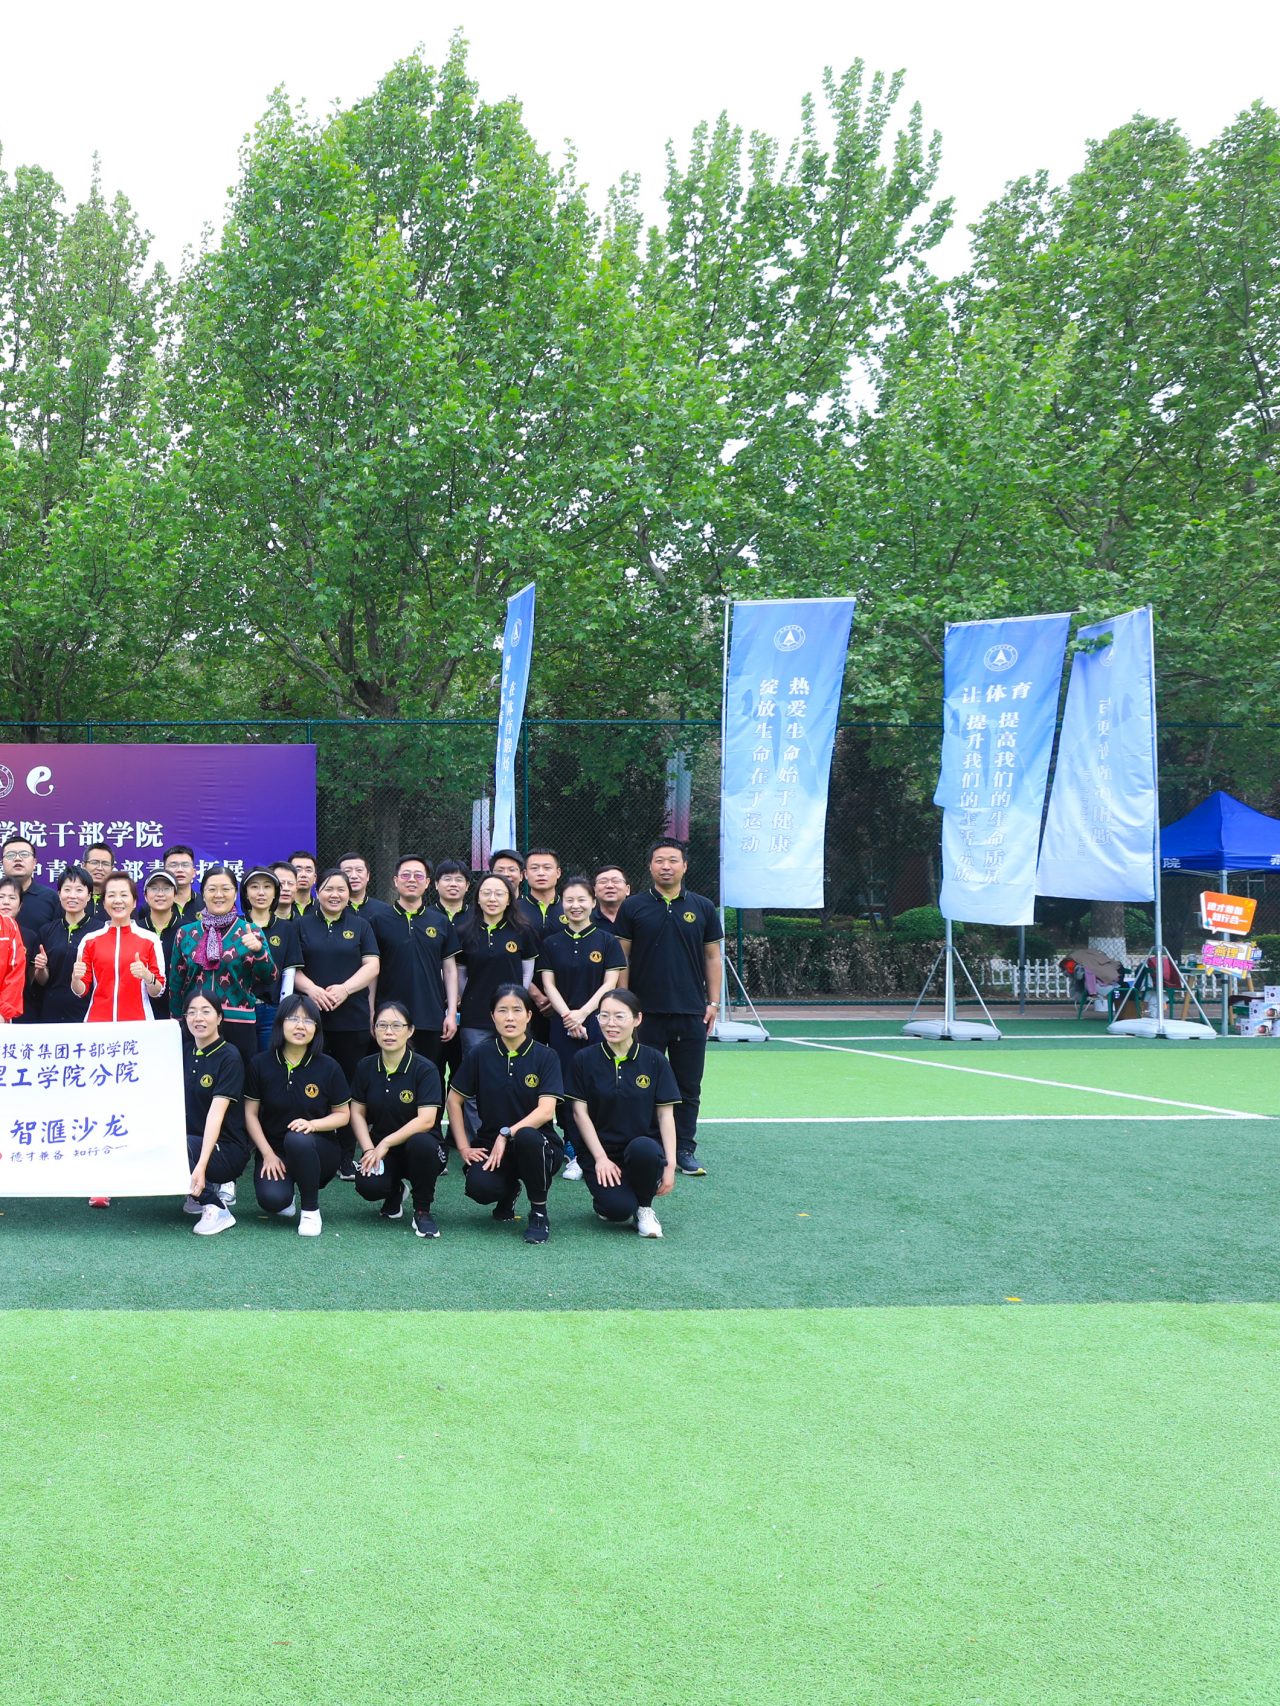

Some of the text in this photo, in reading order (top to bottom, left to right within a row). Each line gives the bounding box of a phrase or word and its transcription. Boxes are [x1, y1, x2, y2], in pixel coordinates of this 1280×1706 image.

[741, 679, 779, 853] 绽放生命在于运动
[769, 677, 810, 853] 热爱生命始于健康
[962, 682, 1032, 704] 让体育
